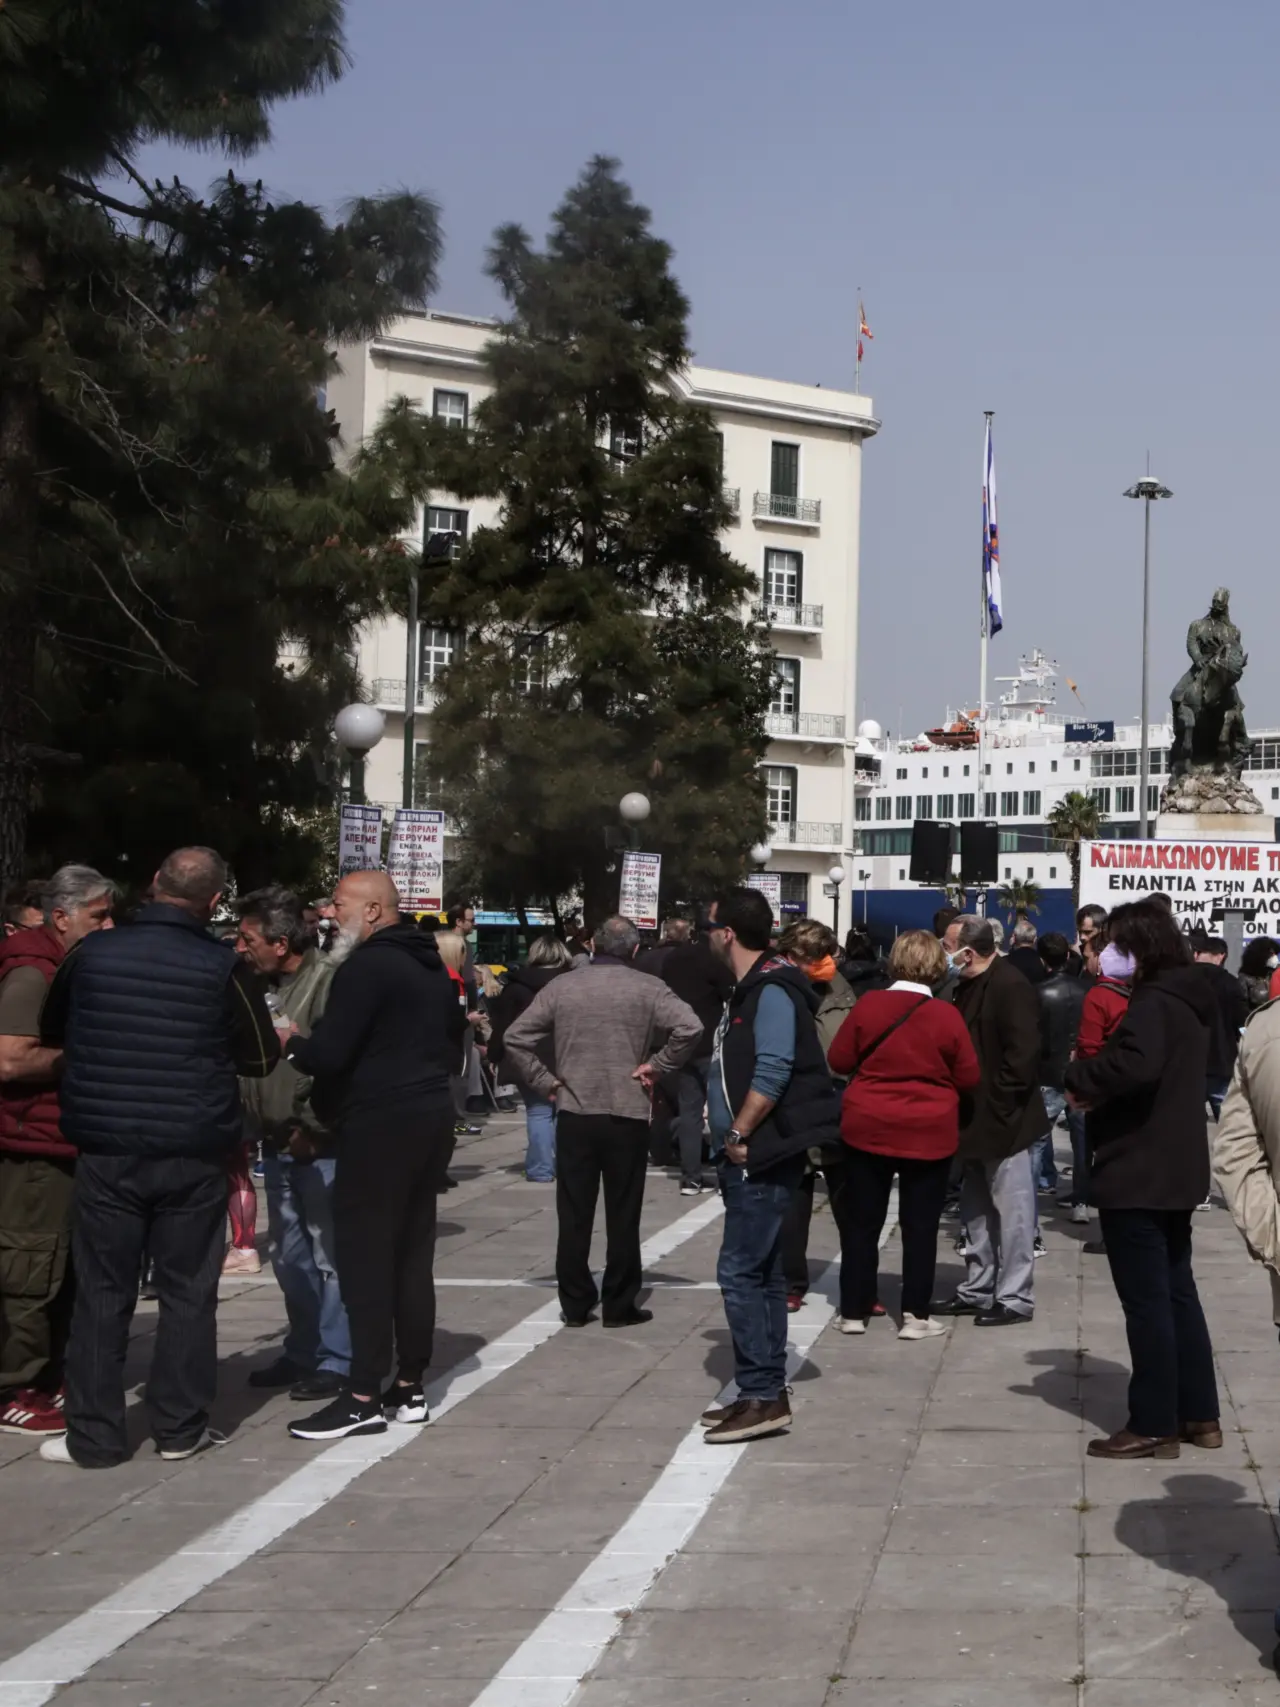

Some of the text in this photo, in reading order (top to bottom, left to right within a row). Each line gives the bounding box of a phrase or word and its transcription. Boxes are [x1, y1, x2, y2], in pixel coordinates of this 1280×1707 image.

[1091, 843, 1259, 870] ΚΛΙΜΑΚΩΝΟΥΜΕ
[1109, 875, 1196, 892] ΕΝΑΝΤΙΑ
[1204, 880, 1244, 892] ΣΤΗΝ
[1174, 900, 1205, 912] ΤΗΝ
